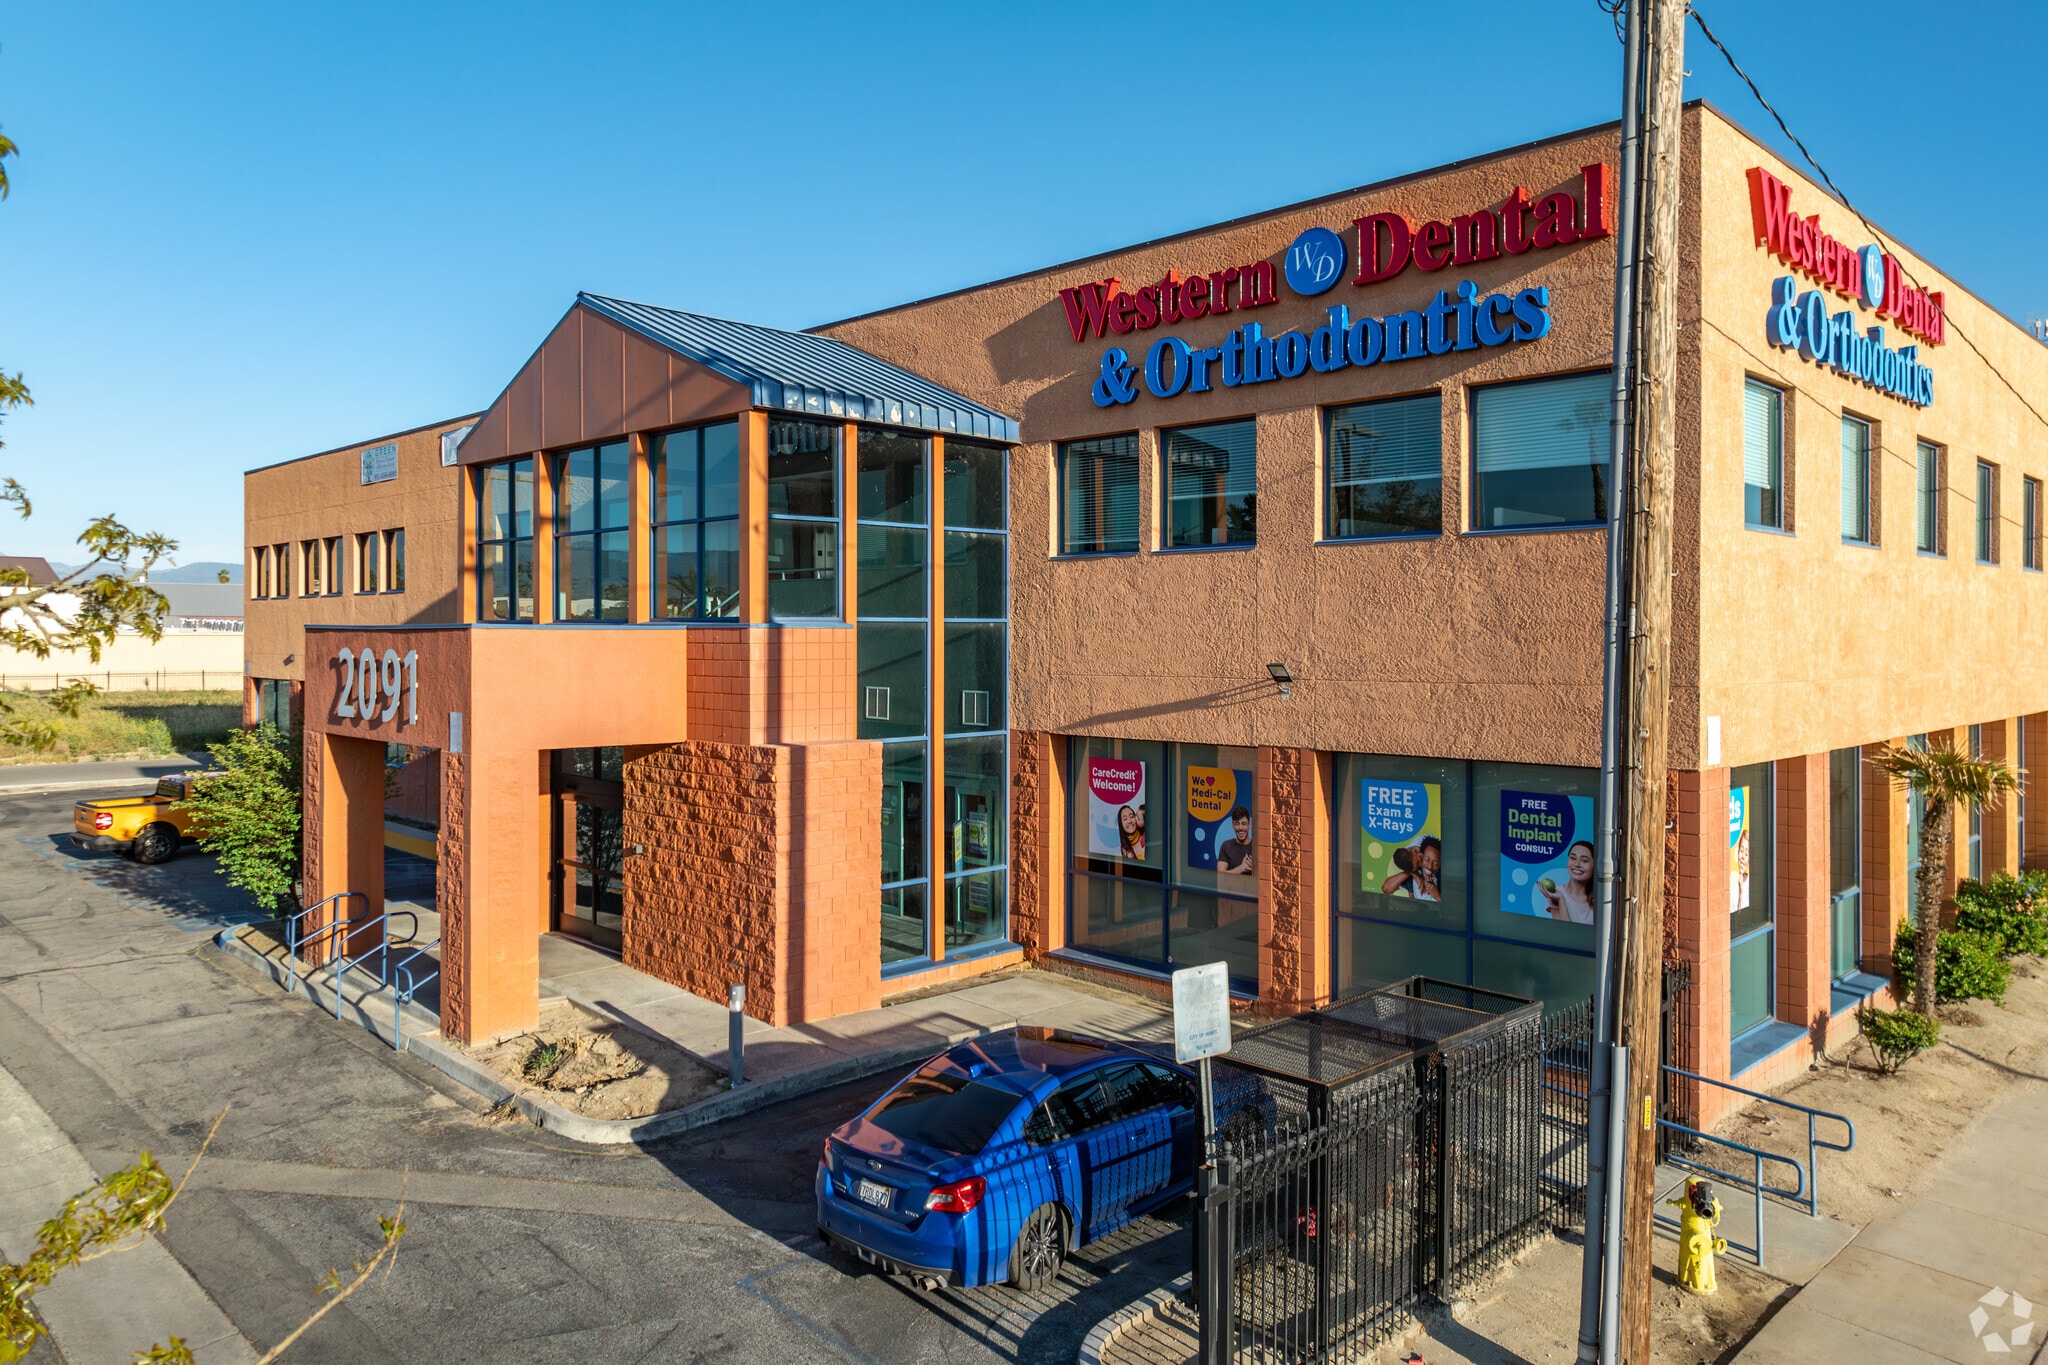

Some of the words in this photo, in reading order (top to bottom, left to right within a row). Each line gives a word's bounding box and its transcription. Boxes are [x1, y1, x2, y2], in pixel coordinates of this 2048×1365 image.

[1059, 261, 1280, 342] Western
[1351, 162, 1613, 286] Dental
[1746, 166, 1862, 299] Western
[1875, 254, 1946, 346] Dental
[1092, 348, 1139, 408] &
[1144, 279, 1551, 398] Orthodontics
[1767, 276, 1802, 350] &
[1797, 290, 1934, 408] Orthodontics
[375, 444, 397, 457] GREEN
[338, 647, 417, 725] 2091
[1092, 767, 1136, 781] CareCredit
[1191, 776, 1205, 786] We
[1092, 778, 1136, 792] Welcome!
[1191, 787, 1231, 800] Medi-Cal
[1191, 798, 1221, 811] Dental
[1368, 804, 1401, 818] Exam
[1404, 807, 1414, 819] &
[1521, 799, 1548, 810] FREE
[1368, 816, 1414, 834] X-Rays
[1508, 808, 1562, 828] Dental
[1508, 826, 1562, 844] Implant
[1515, 842, 1554, 855] CONSULT
